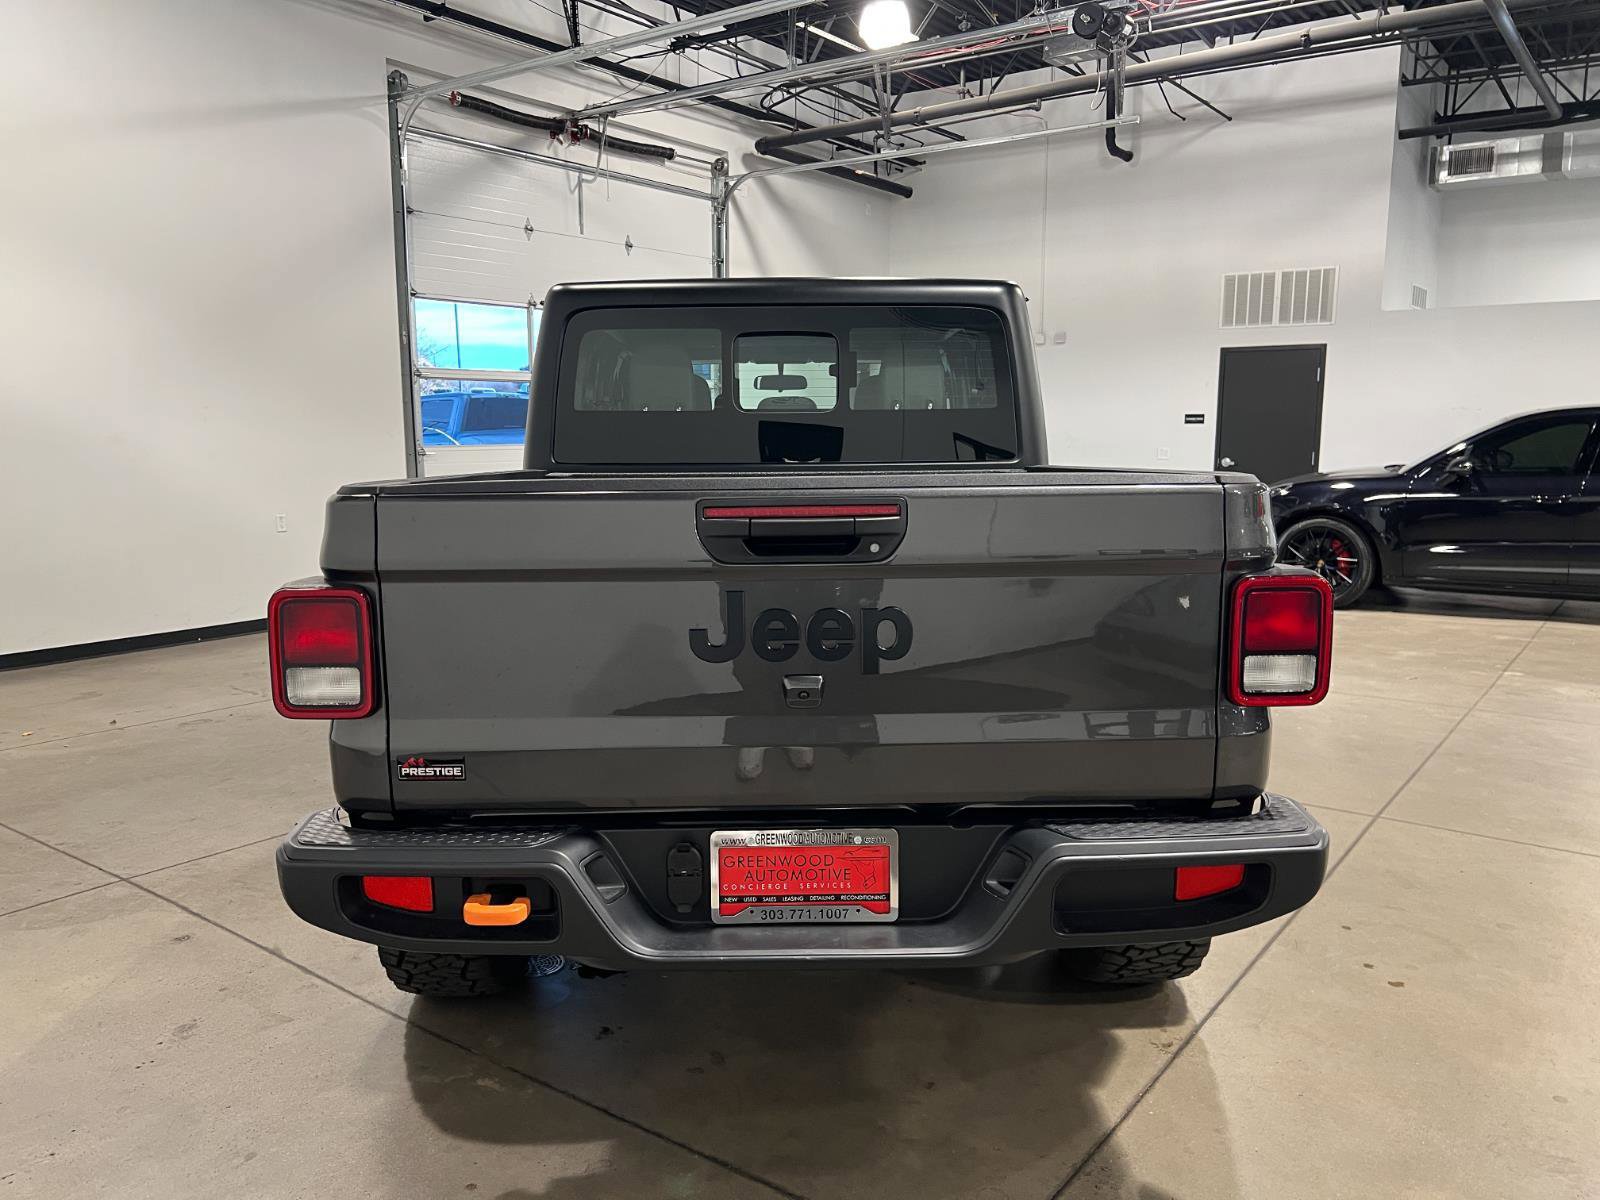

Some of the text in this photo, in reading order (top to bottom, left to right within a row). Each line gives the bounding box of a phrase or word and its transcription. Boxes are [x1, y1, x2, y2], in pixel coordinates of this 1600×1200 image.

[689, 590, 913, 675] Jeep
[401, 767, 462, 776] PRESTIGE
[723, 854, 834, 868] GREENWOOD
[744, 868, 851, 882] AUTOMOTIVE
[760, 909, 850, 920] 303.771.1007
